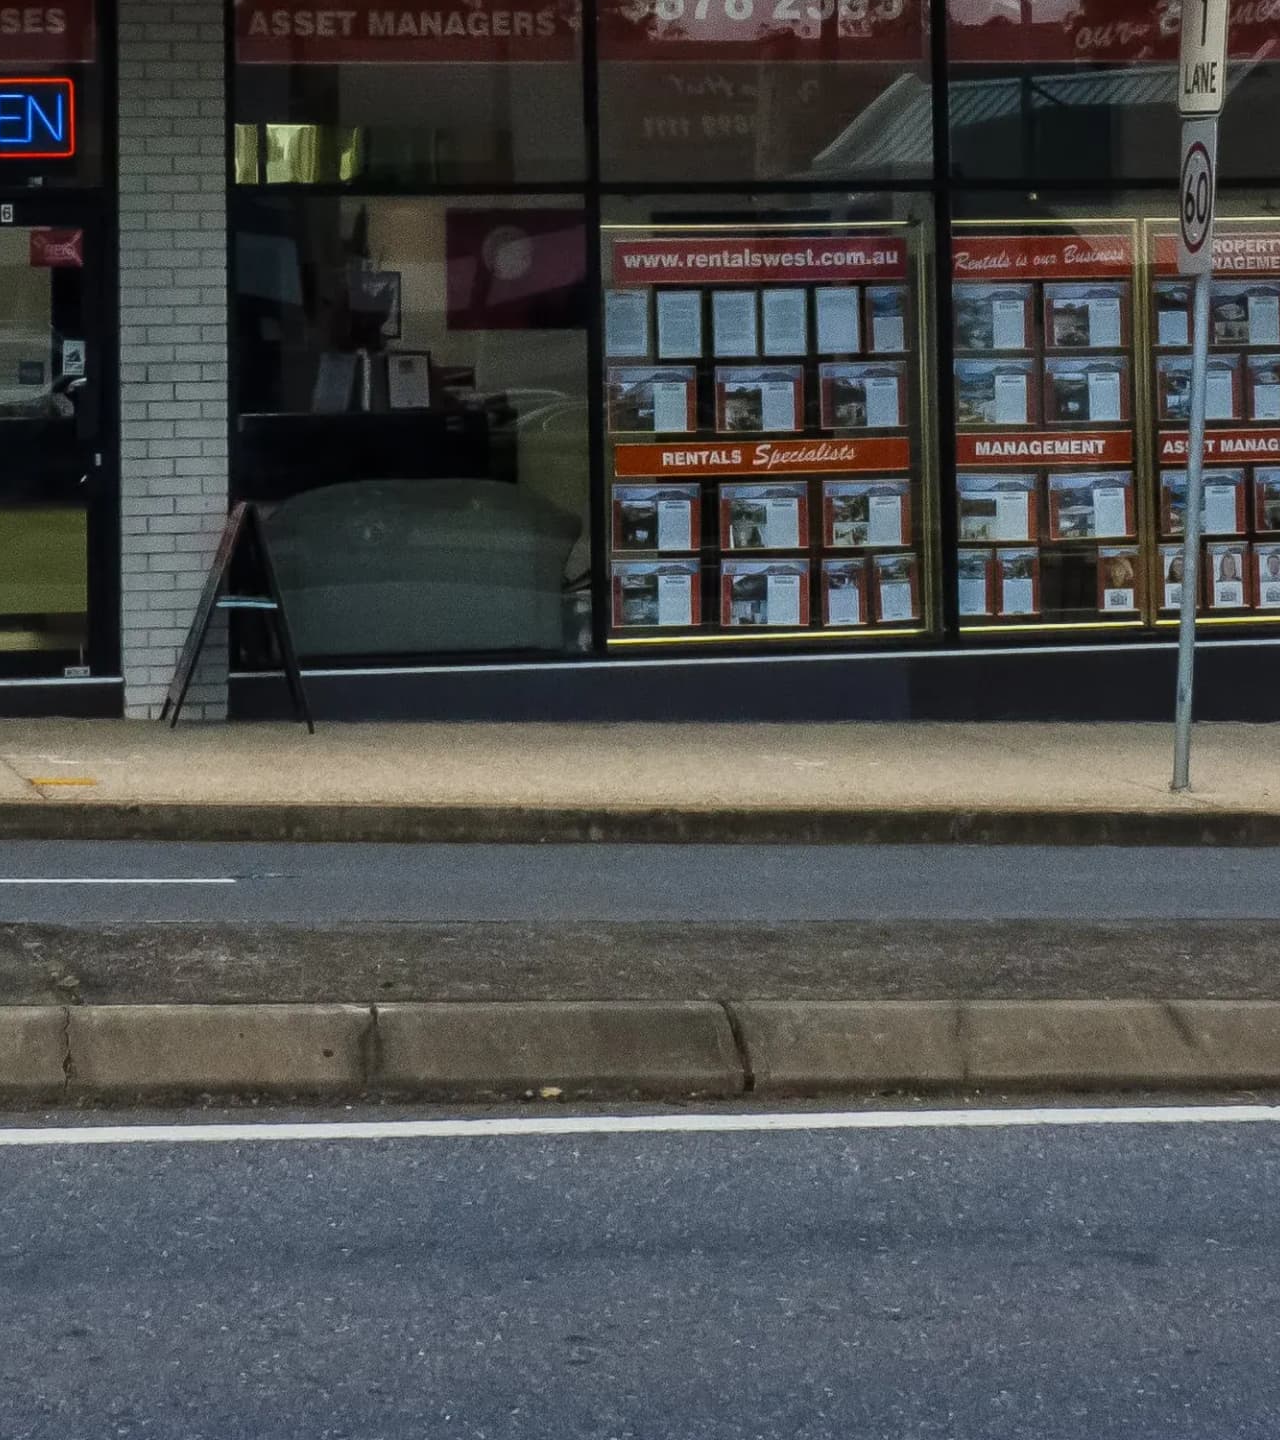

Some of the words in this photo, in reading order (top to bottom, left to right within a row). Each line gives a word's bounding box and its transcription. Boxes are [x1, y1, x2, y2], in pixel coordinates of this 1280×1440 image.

[249, 11, 358, 37] ASSET
[368, 10, 556, 38] MANAGERS
[1184, 61, 1217, 95] LANE
[1184, 172, 1208, 224] 60
[624, 248, 899, 268] www.rentalswest.com.au
[662, 450, 742, 466] RENTALS
[753, 443, 856, 469] Specialists
[975, 439, 1106, 456] MANAGEMENT
